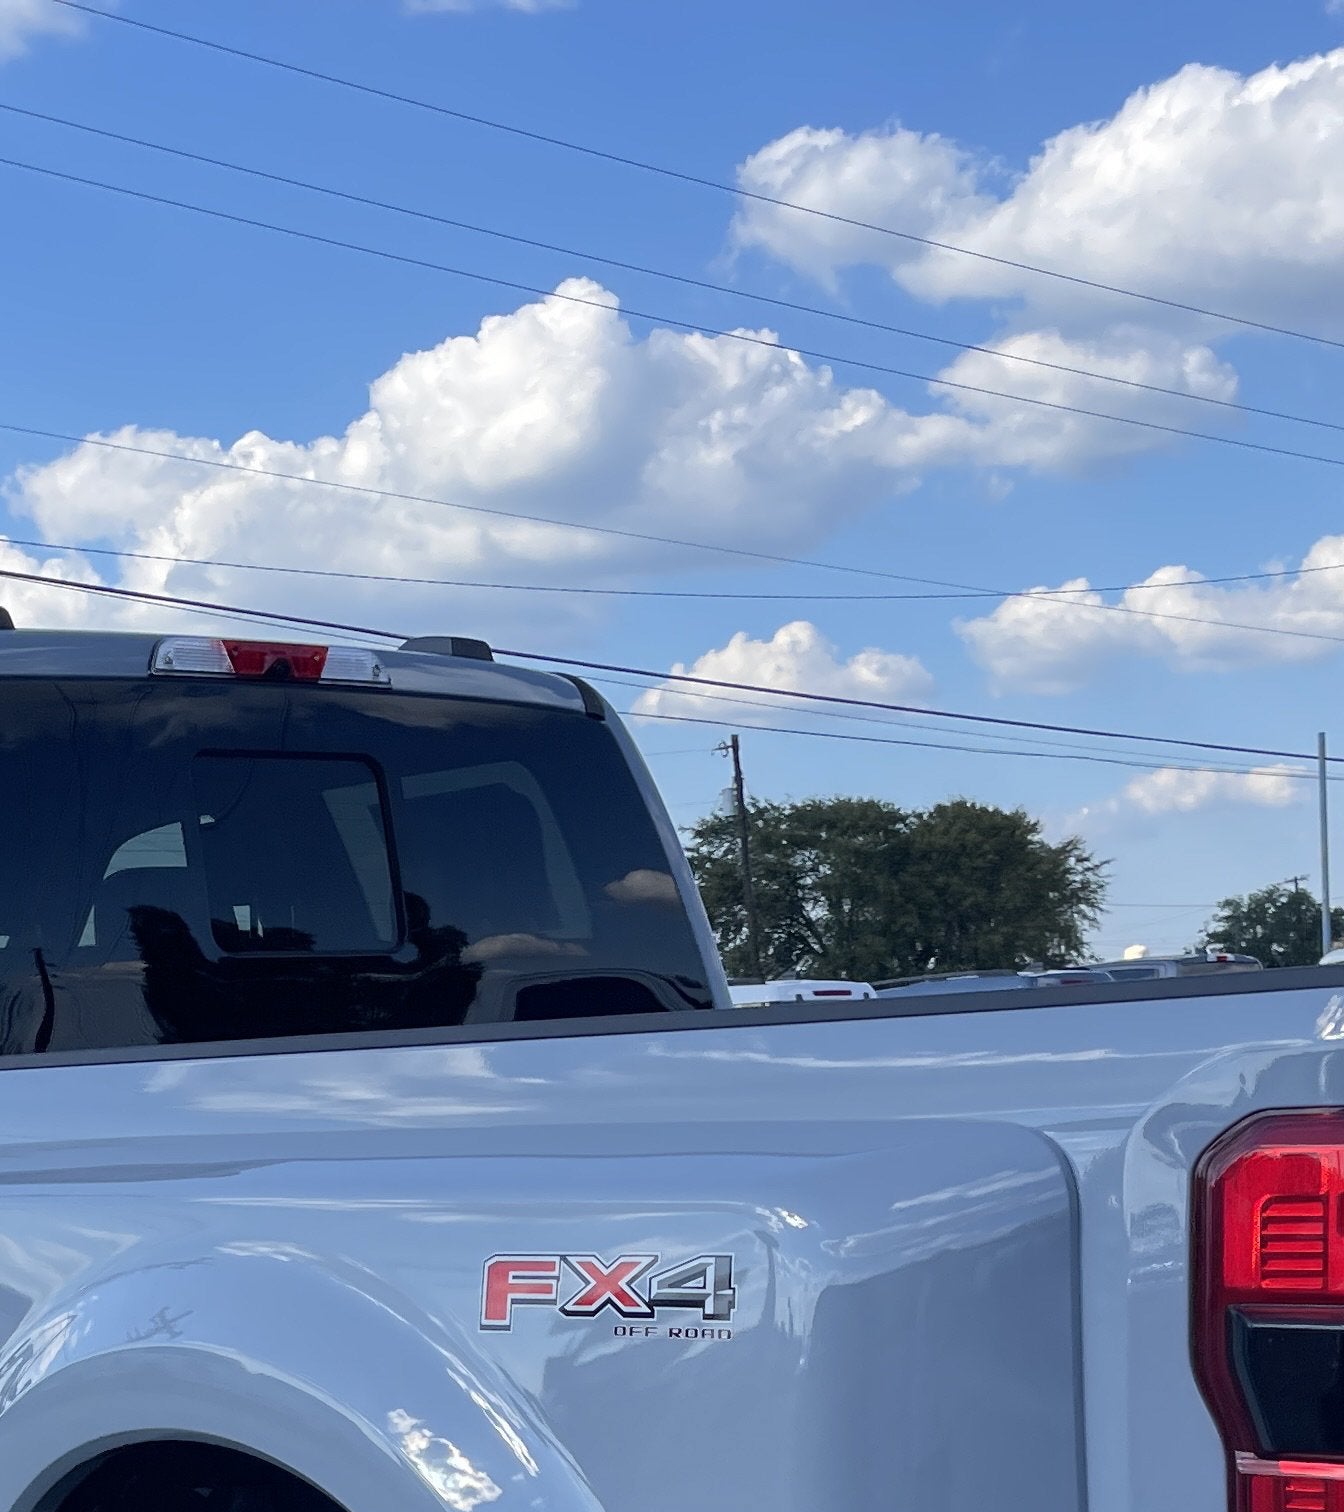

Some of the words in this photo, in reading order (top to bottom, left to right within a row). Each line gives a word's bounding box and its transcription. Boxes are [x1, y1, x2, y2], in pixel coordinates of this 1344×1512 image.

[479, 1252, 737, 1333] FX4
[613, 1325, 658, 1338] OFF
[668, 1327, 732, 1340] ROAD
